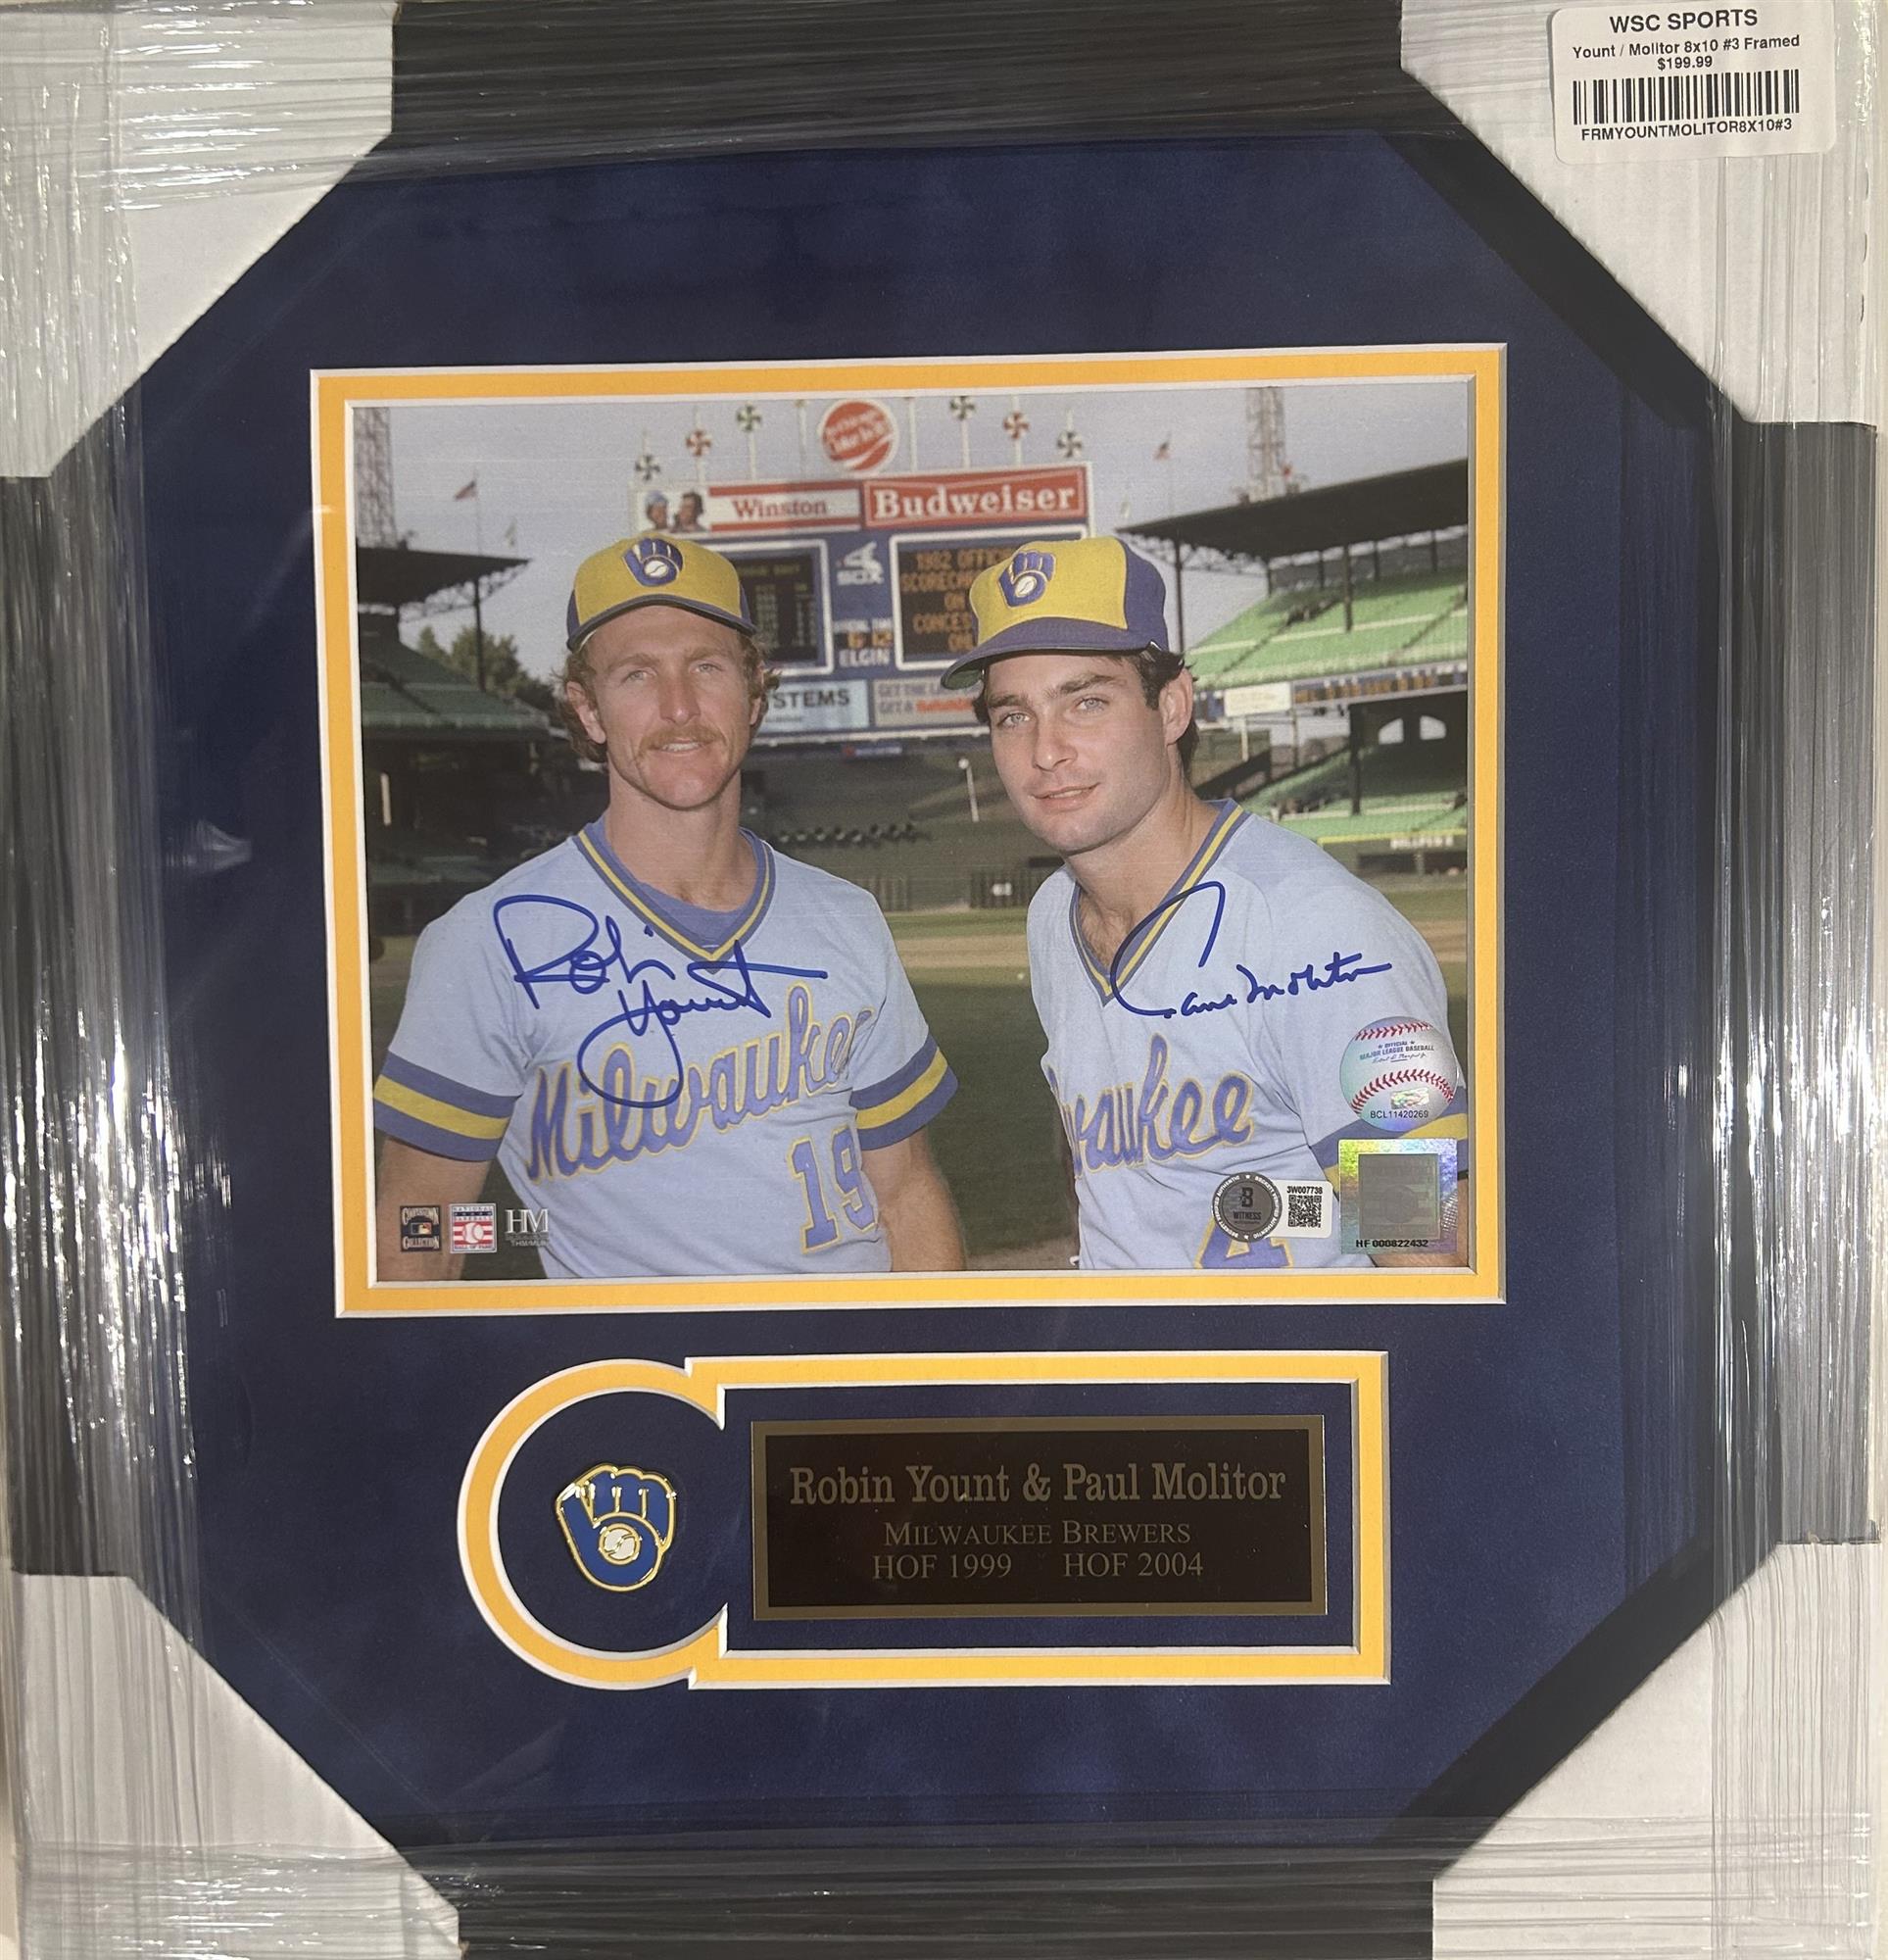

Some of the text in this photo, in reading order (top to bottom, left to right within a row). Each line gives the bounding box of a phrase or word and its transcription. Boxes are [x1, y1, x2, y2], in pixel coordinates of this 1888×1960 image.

[1610, 9, 1759, 33] WSC SPORTS
[1573, 34, 1800, 59] Yount / Molitor 8x10 #3 Framed
[1657, 56, 1714, 71] $199.99
[1581, 118, 1793, 140] FRMYOUNTMOLITOR8X10#3
[732, 497, 828, 520] Winston
[873, 485, 1076, 519] Budweiser
[839, 648, 891, 668] ELGIN
[1382, 1046, 1404, 1055] LEAGUE
[1370, 1109, 1429, 1119] BCL11420269
[787, 1124, 880, 1254] 19
[1234, 1211, 1261, 1220] WITNESS
[790, 1461, 1286, 1504] Robin Yount & Paul Molitor
[884, 1520, 1191, 1546] MILWAUKEE BREWERS
[872, 1551, 1204, 1580] HOF 1999 HOF 2004
